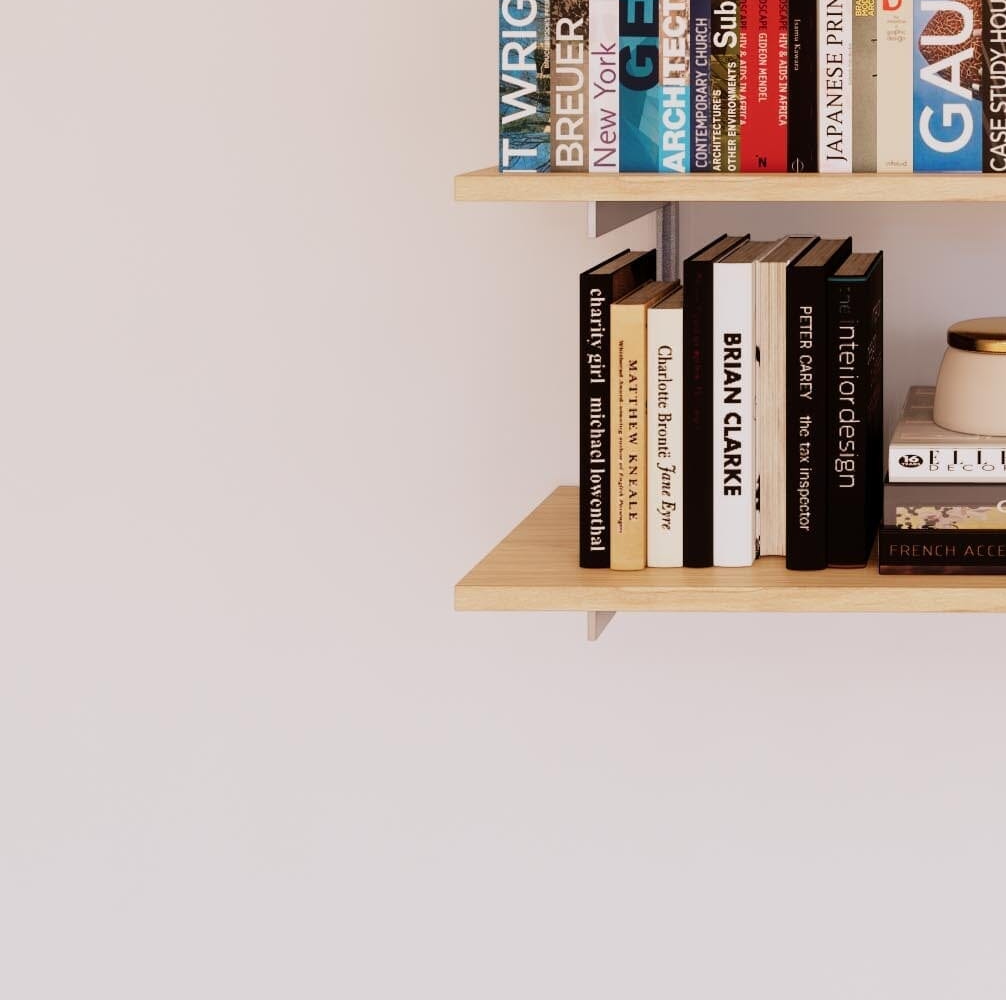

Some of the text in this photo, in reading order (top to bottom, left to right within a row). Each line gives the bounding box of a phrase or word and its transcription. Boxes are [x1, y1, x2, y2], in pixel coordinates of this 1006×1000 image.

[740, 33, 748, 49] HIV
[758, 33, 767, 66] GIDEON
[779, 33, 788, 49] HIV
[740, 60, 748, 81] AIDS
[740, 83, 748, 93] IN
[758, 68, 767, 103] MENDEL
[779, 60, 788, 81] AIDS
[779, 83, 788, 93] IN
[555, 17, 585, 167] BREUER
[591, 42, 617, 167] New York
[695, 18, 709, 168] CONTEMPORARY CHURCH
[826, 53, 847, 161] JAPANESE
[727, 61, 737, 171] OTHER ENVIRONMENTS
[740, 95, 748, 126] AFRICA
[779, 95, 788, 126] AFRICA
[587, 288, 605, 552] charity girl michael lowenthal
[723, 333, 742, 496] BRIAN CLARKE
[797, 306, 812, 532] PETER CAREY the tax inspector
[629, 359, 638, 521] MATTHEW KNEALE
[656, 345, 676, 531] Charlotte Brontë Jane Eyre
[889, 544, 956, 557] FRENCH
